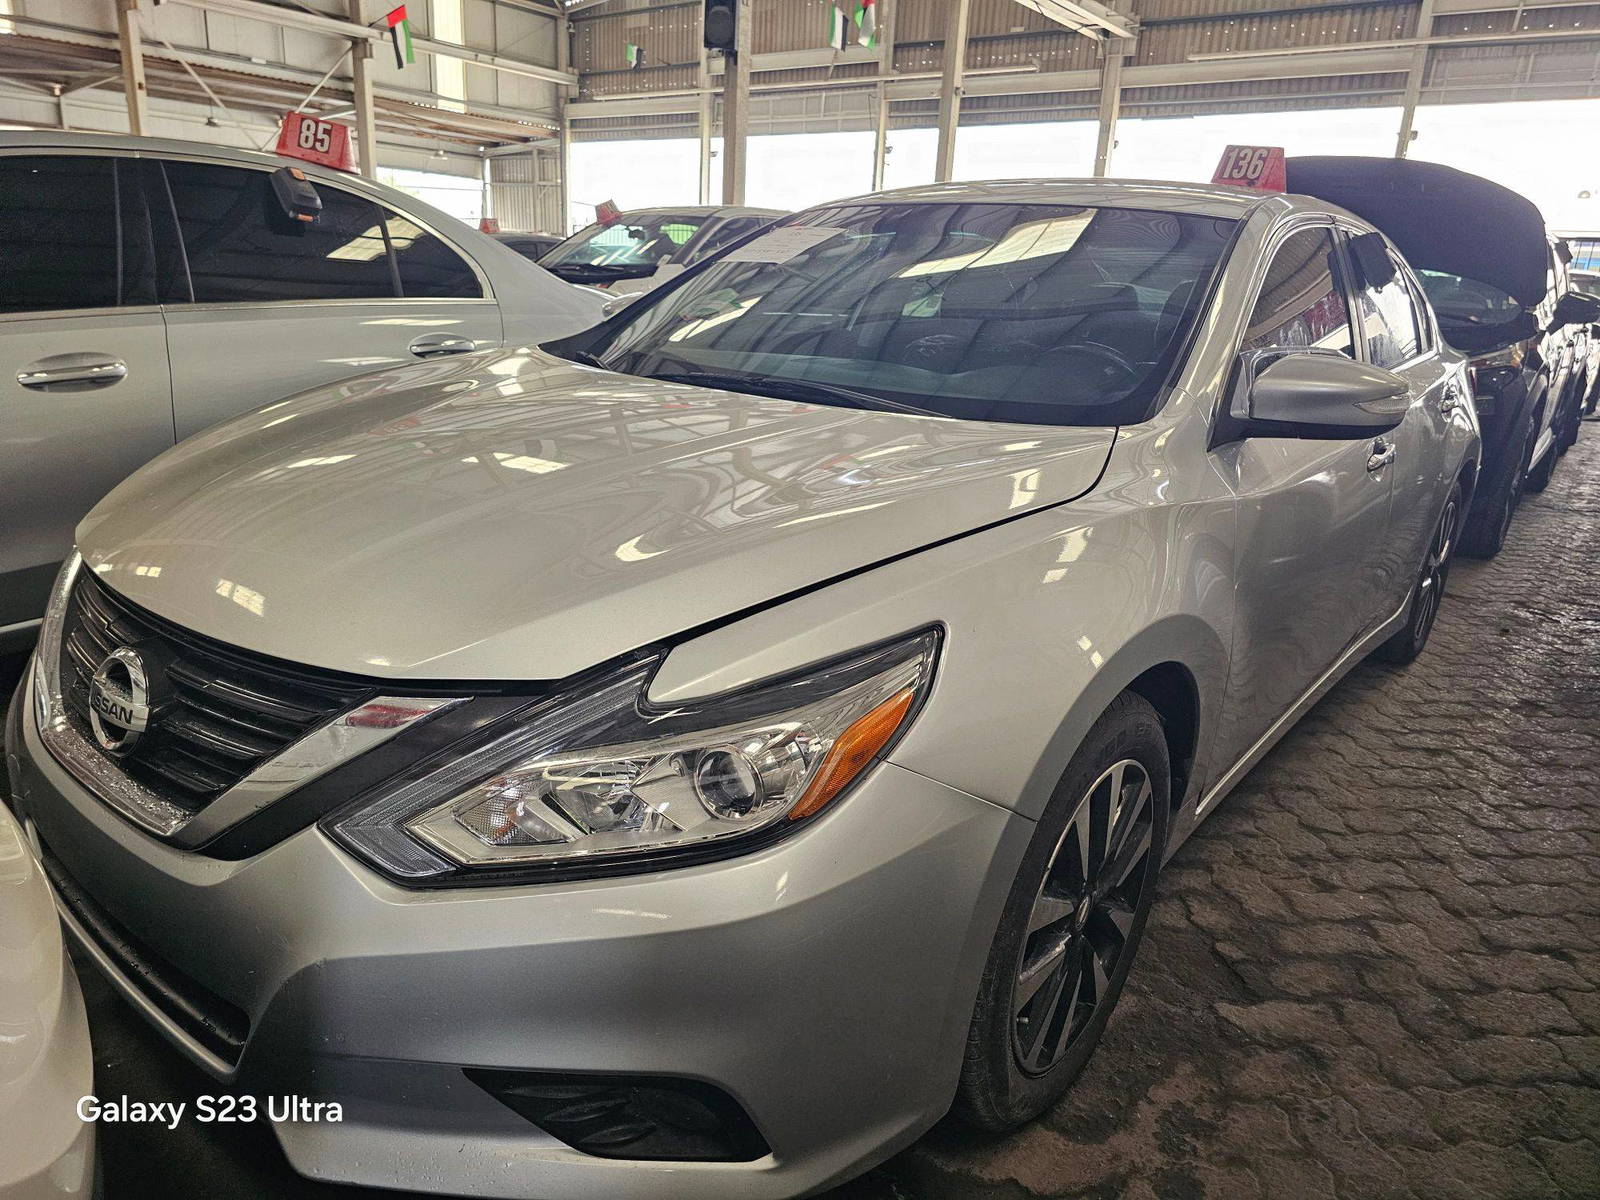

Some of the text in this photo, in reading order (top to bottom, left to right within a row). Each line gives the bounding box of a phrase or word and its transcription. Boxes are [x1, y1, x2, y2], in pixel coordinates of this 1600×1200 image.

[300, 119, 332, 153] 85
[1222, 148, 1268, 180] 136
[91, 690, 133, 725] SSAN
